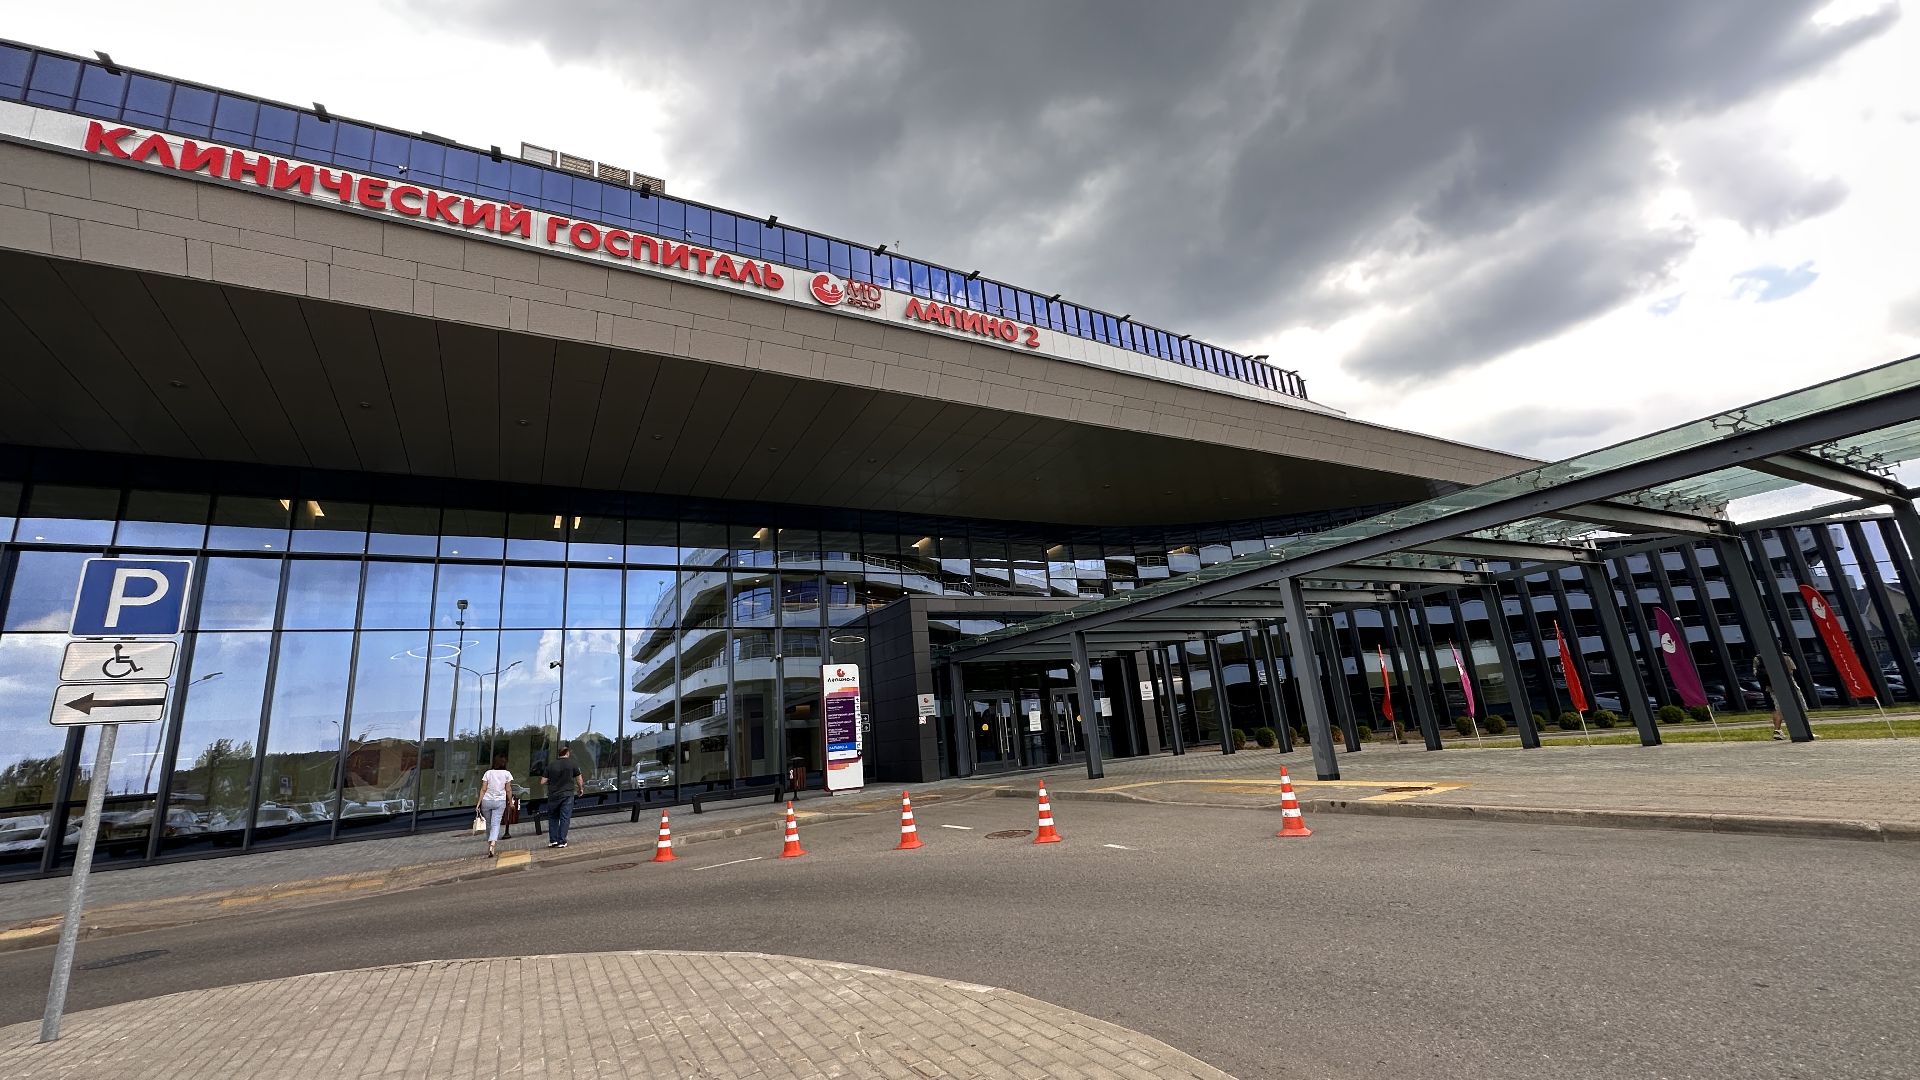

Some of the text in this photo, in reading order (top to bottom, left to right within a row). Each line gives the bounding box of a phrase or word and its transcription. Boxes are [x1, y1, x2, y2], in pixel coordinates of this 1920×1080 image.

[85, 121, 784, 291] КЛИНИЧЕСКИЙ ГОСПИТАЛЬ
[905, 297, 1041, 347] ЛАПИНО 2
[104, 568, 169, 628] P
